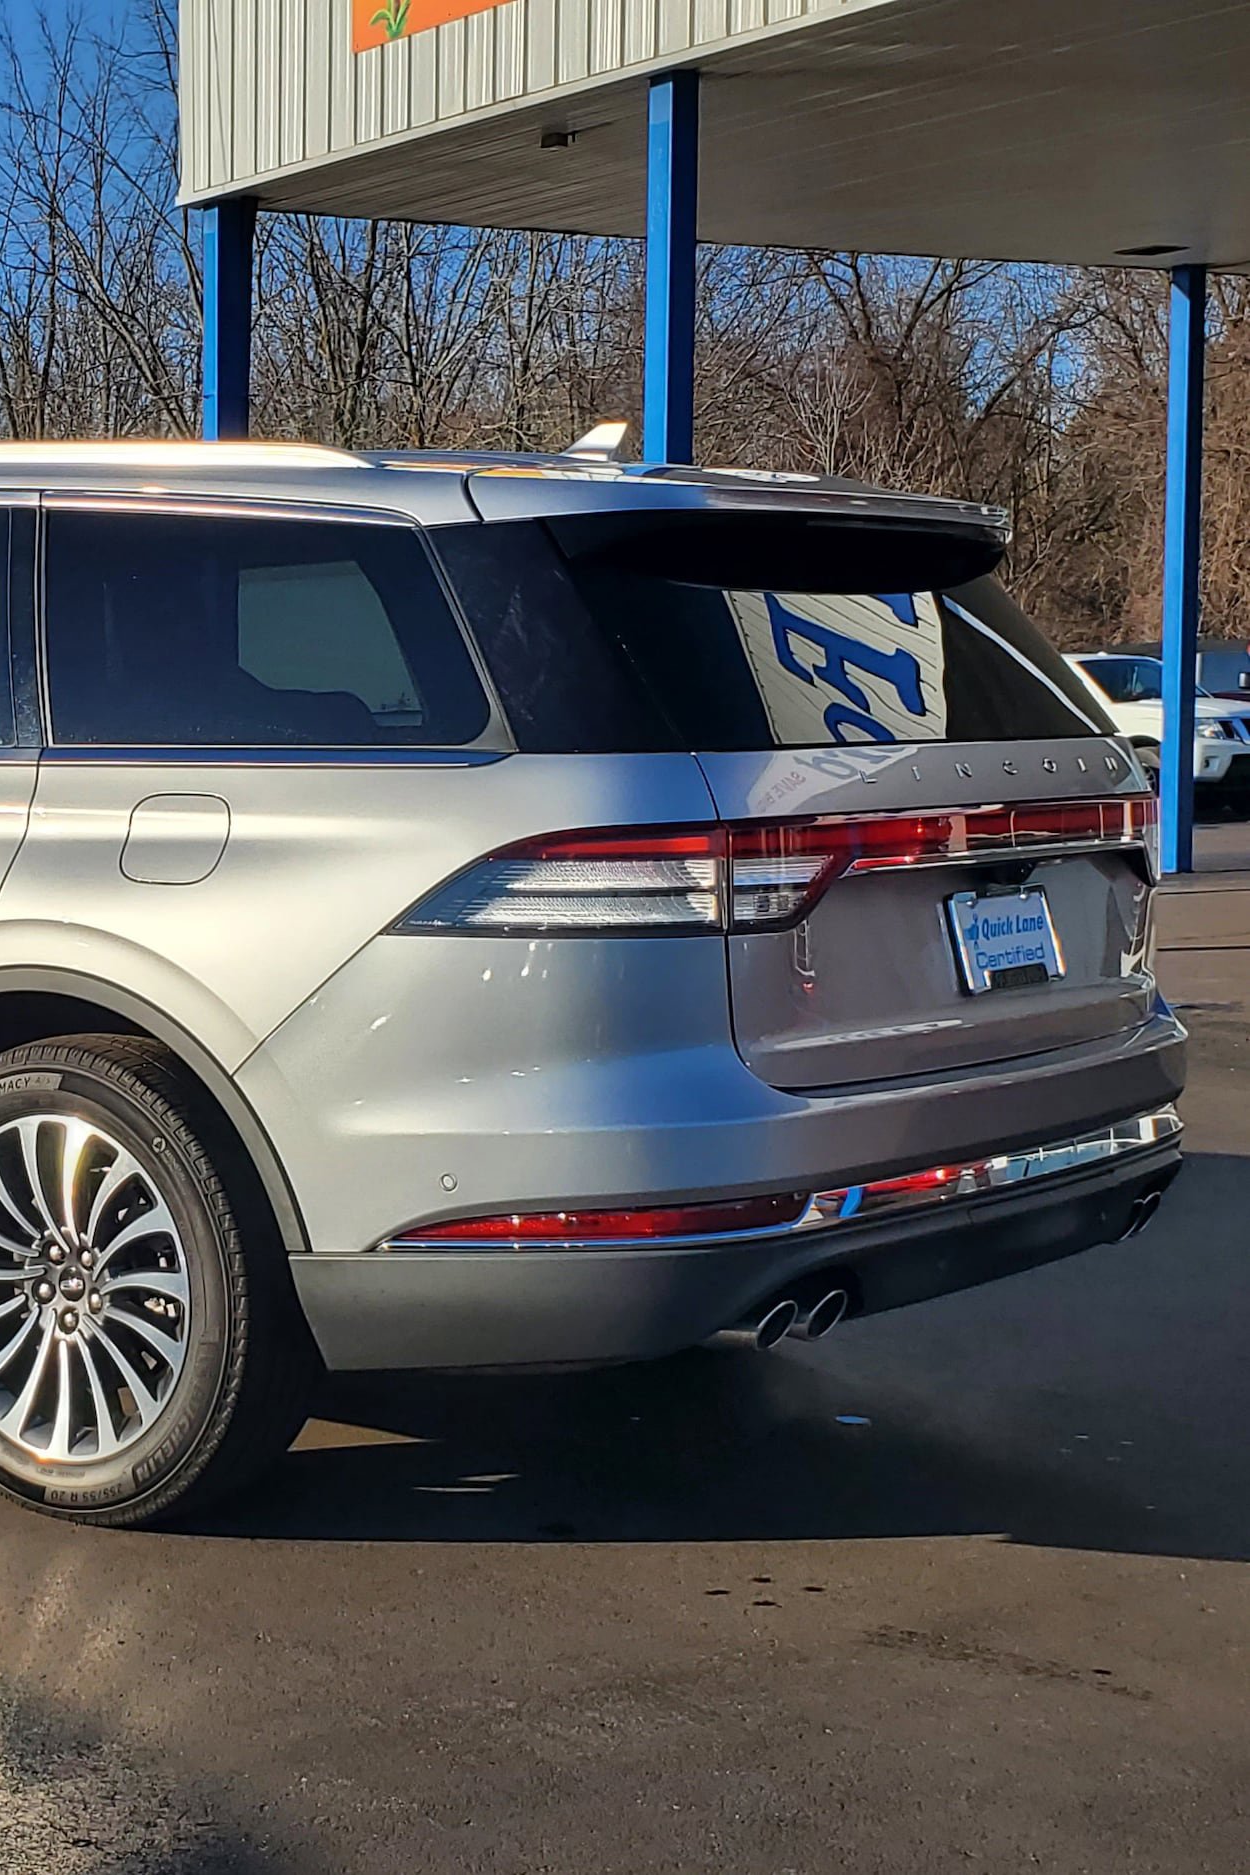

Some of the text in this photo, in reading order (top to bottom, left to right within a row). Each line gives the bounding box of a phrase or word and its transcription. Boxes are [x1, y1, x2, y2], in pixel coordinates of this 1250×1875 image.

[981, 913, 1044, 940] Quick Lane
[975, 942, 1045, 969] Certified
[51, 1489, 66, 1501] 20
[70, 1490, 80, 1502] R
